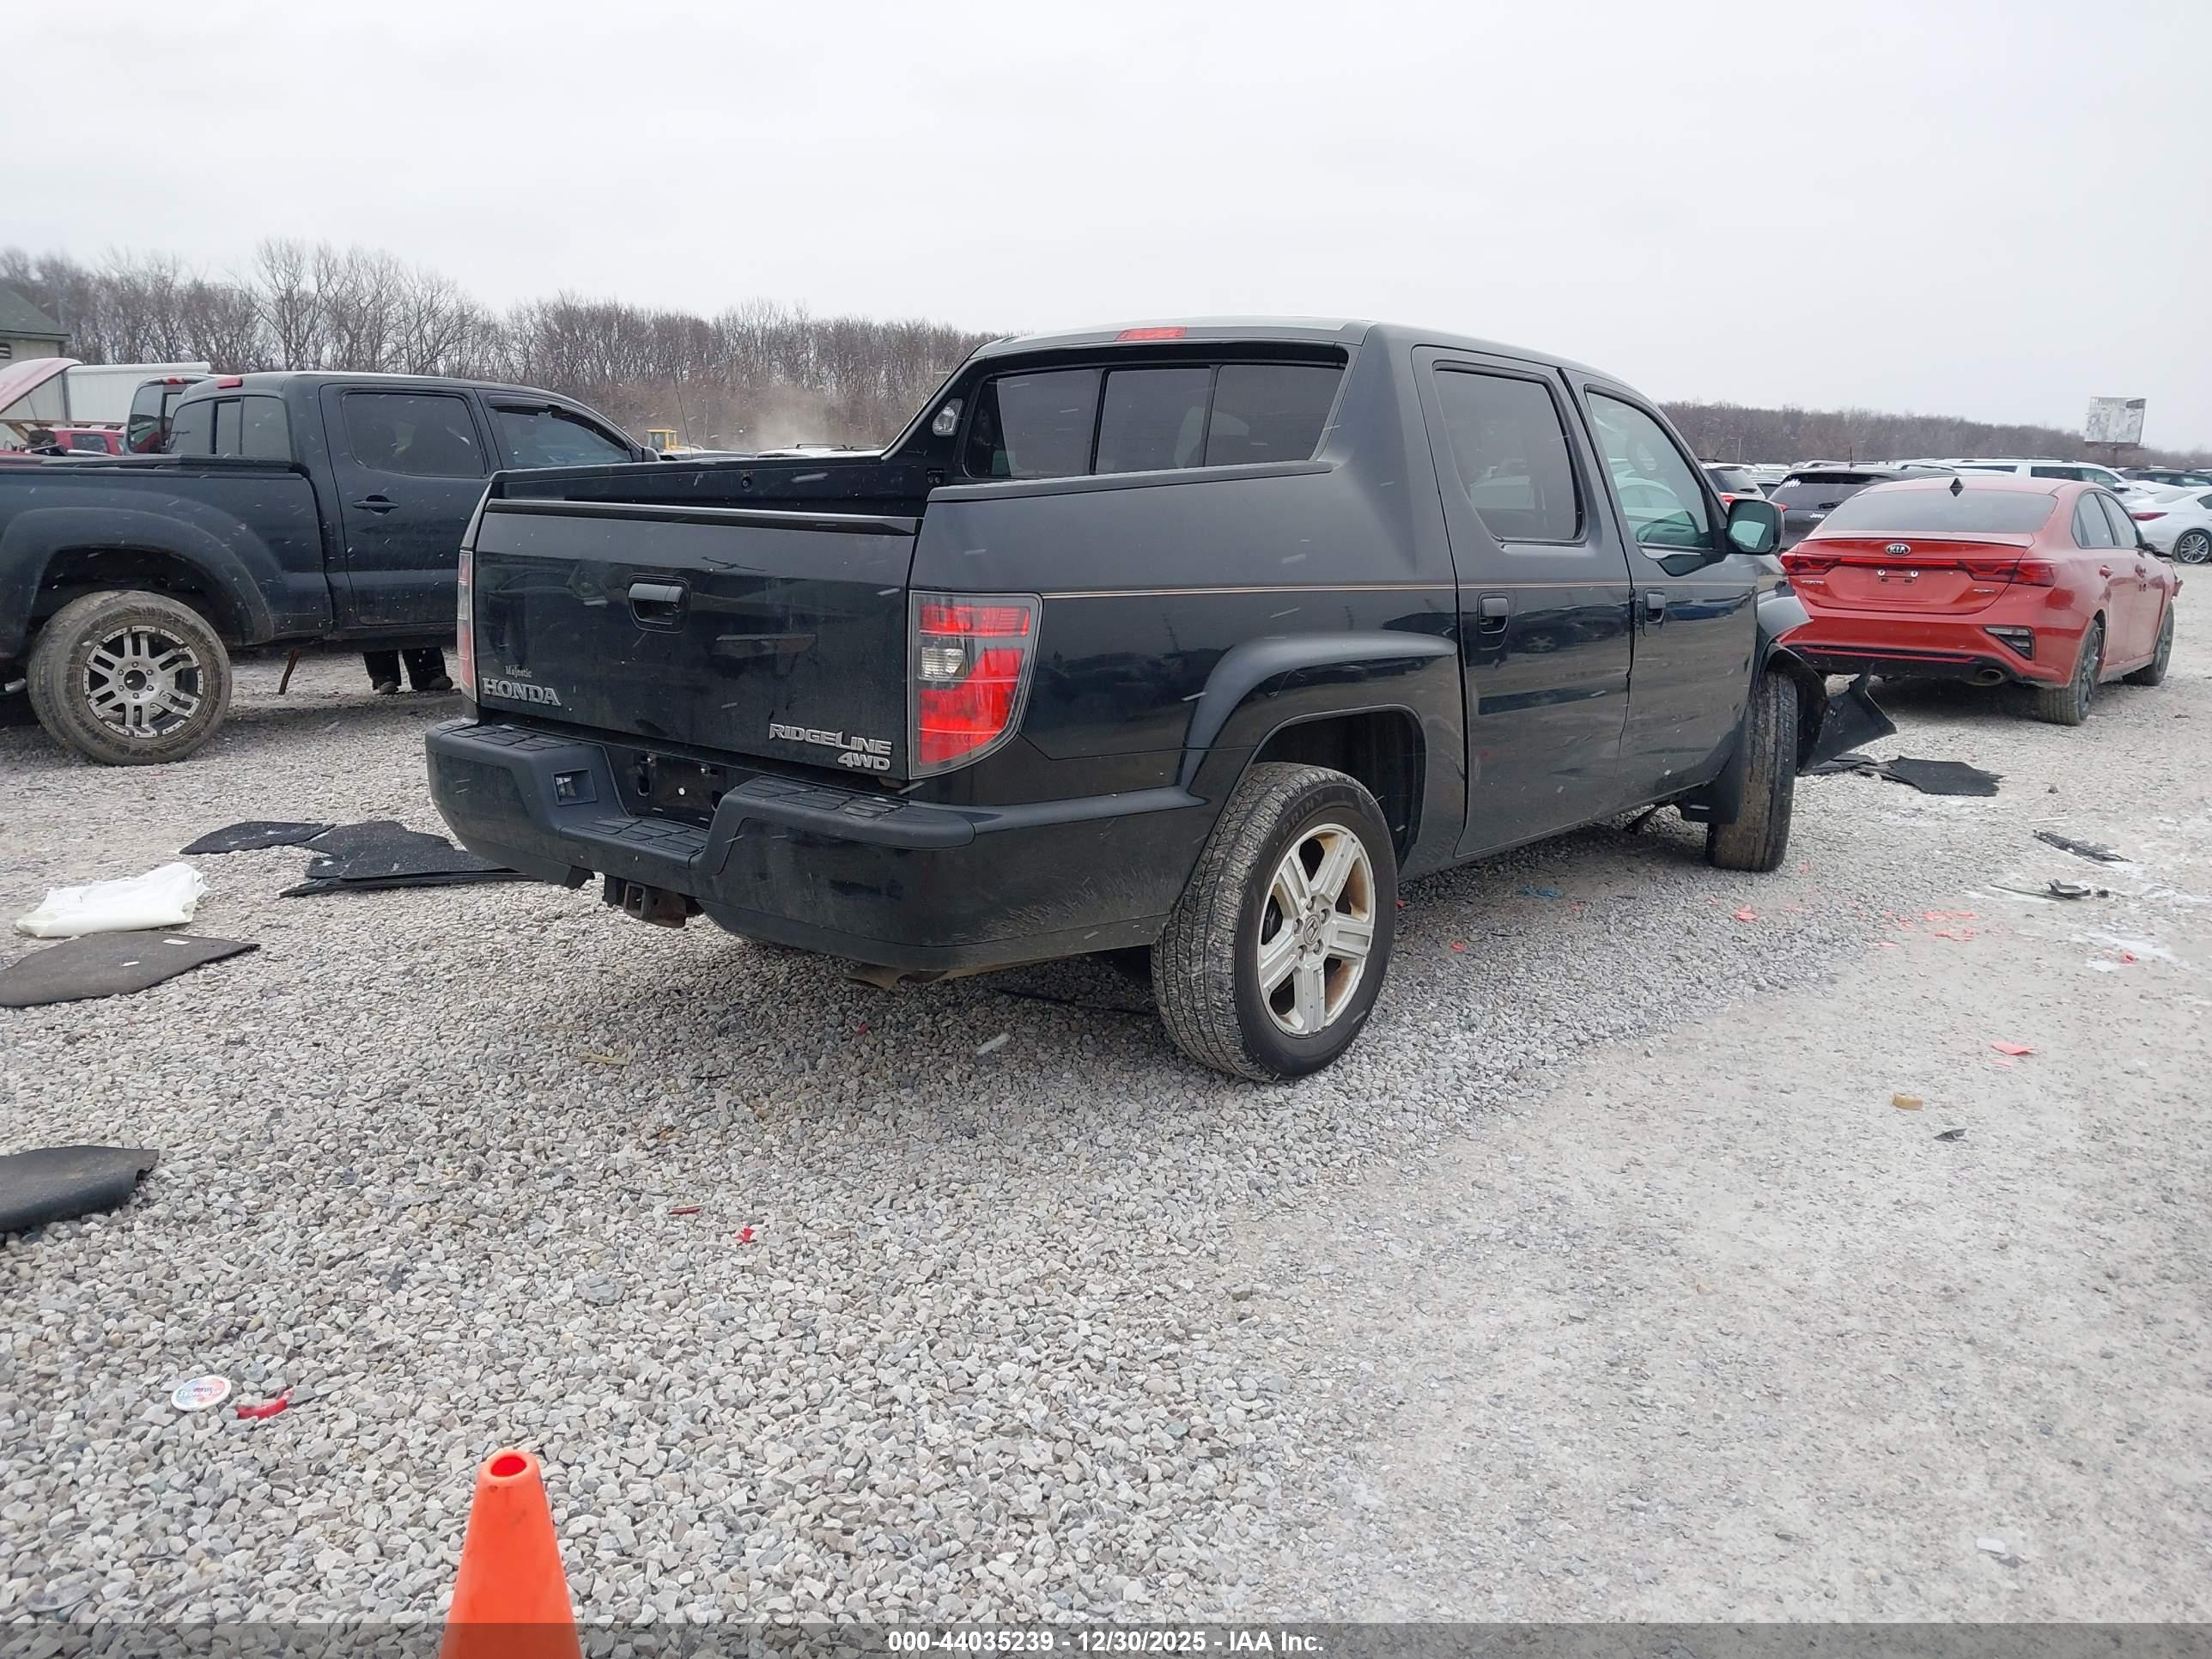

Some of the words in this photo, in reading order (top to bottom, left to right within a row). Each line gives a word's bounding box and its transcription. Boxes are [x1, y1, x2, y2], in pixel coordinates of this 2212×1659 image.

[1890, 545, 1906, 554] KIA
[505, 665, 532, 678] Majestic
[482, 678, 562, 706] HONDA
[769, 723, 892, 756] RIDGELINE
[837, 751, 890, 771] 4WD
